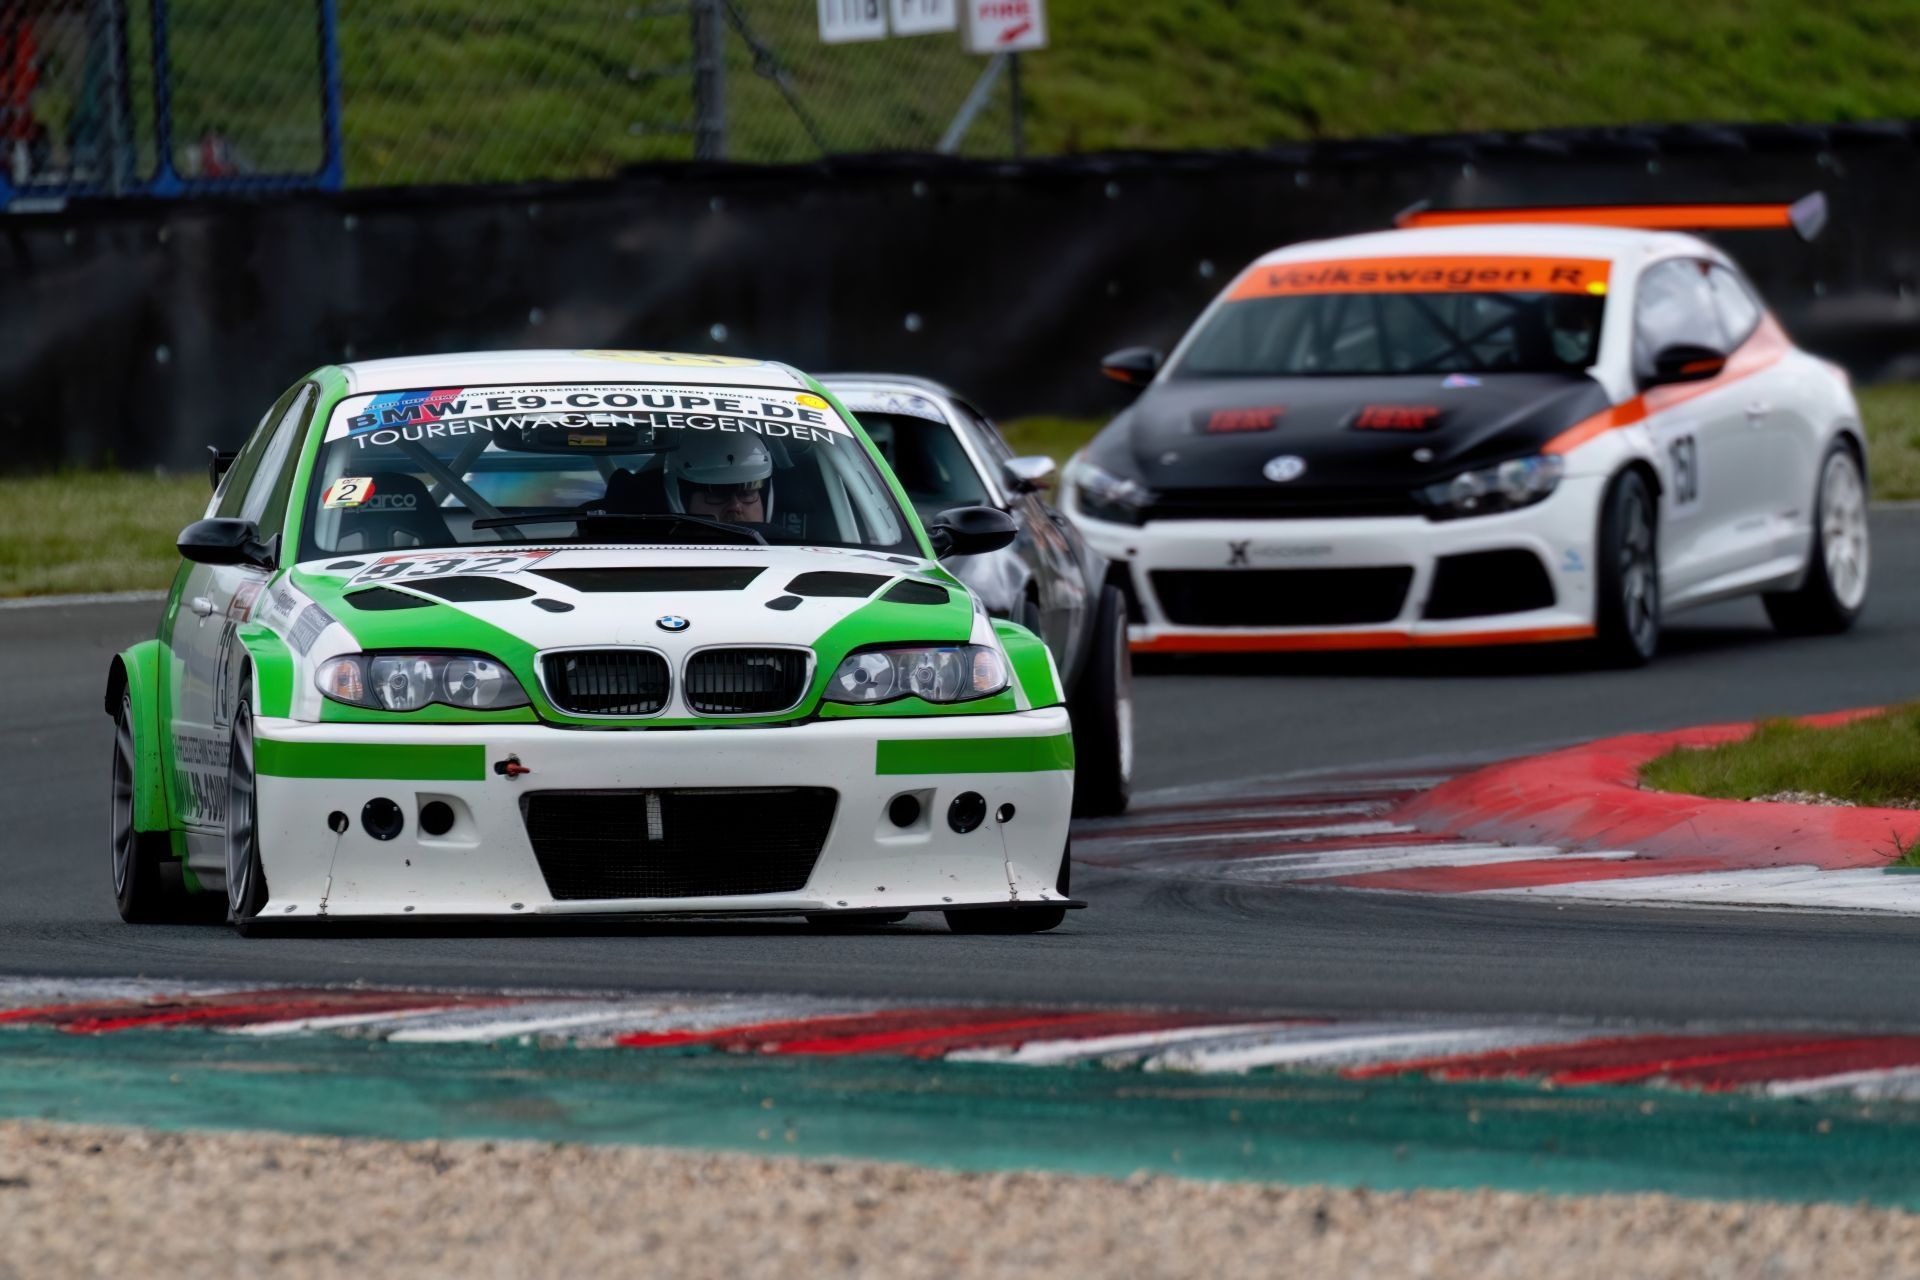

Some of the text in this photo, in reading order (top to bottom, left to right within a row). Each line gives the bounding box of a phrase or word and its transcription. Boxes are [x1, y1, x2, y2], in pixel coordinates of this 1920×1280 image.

[1268, 264, 1584, 288] Volkswagen R
[593, 387, 704, 396] RESTAURATIONEN
[708, 391, 753, 400] FINDEN
[346, 393, 827, 431] BMW-E9-COUPE.DE
[352, 413, 835, 449] TOURENWAGEN LEGENDEN
[336, 484, 357, 501] 2
[355, 557, 518, 583] 932
